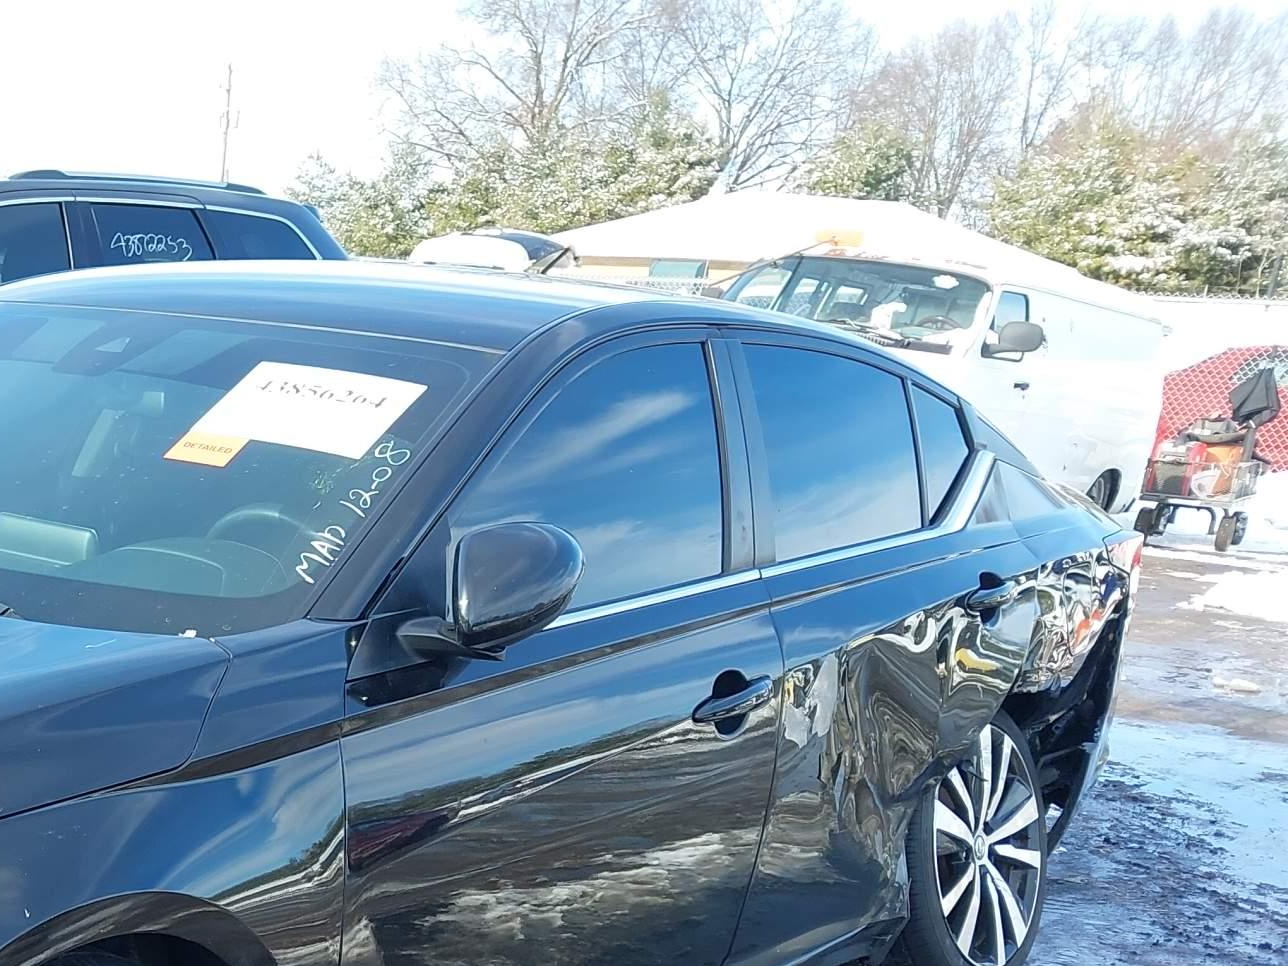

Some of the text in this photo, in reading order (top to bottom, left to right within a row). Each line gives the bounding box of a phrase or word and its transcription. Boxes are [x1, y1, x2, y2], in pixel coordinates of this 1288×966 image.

[183, 441, 233, 455] DETAILED
[295, 439, 411, 584] MAD 12-08
